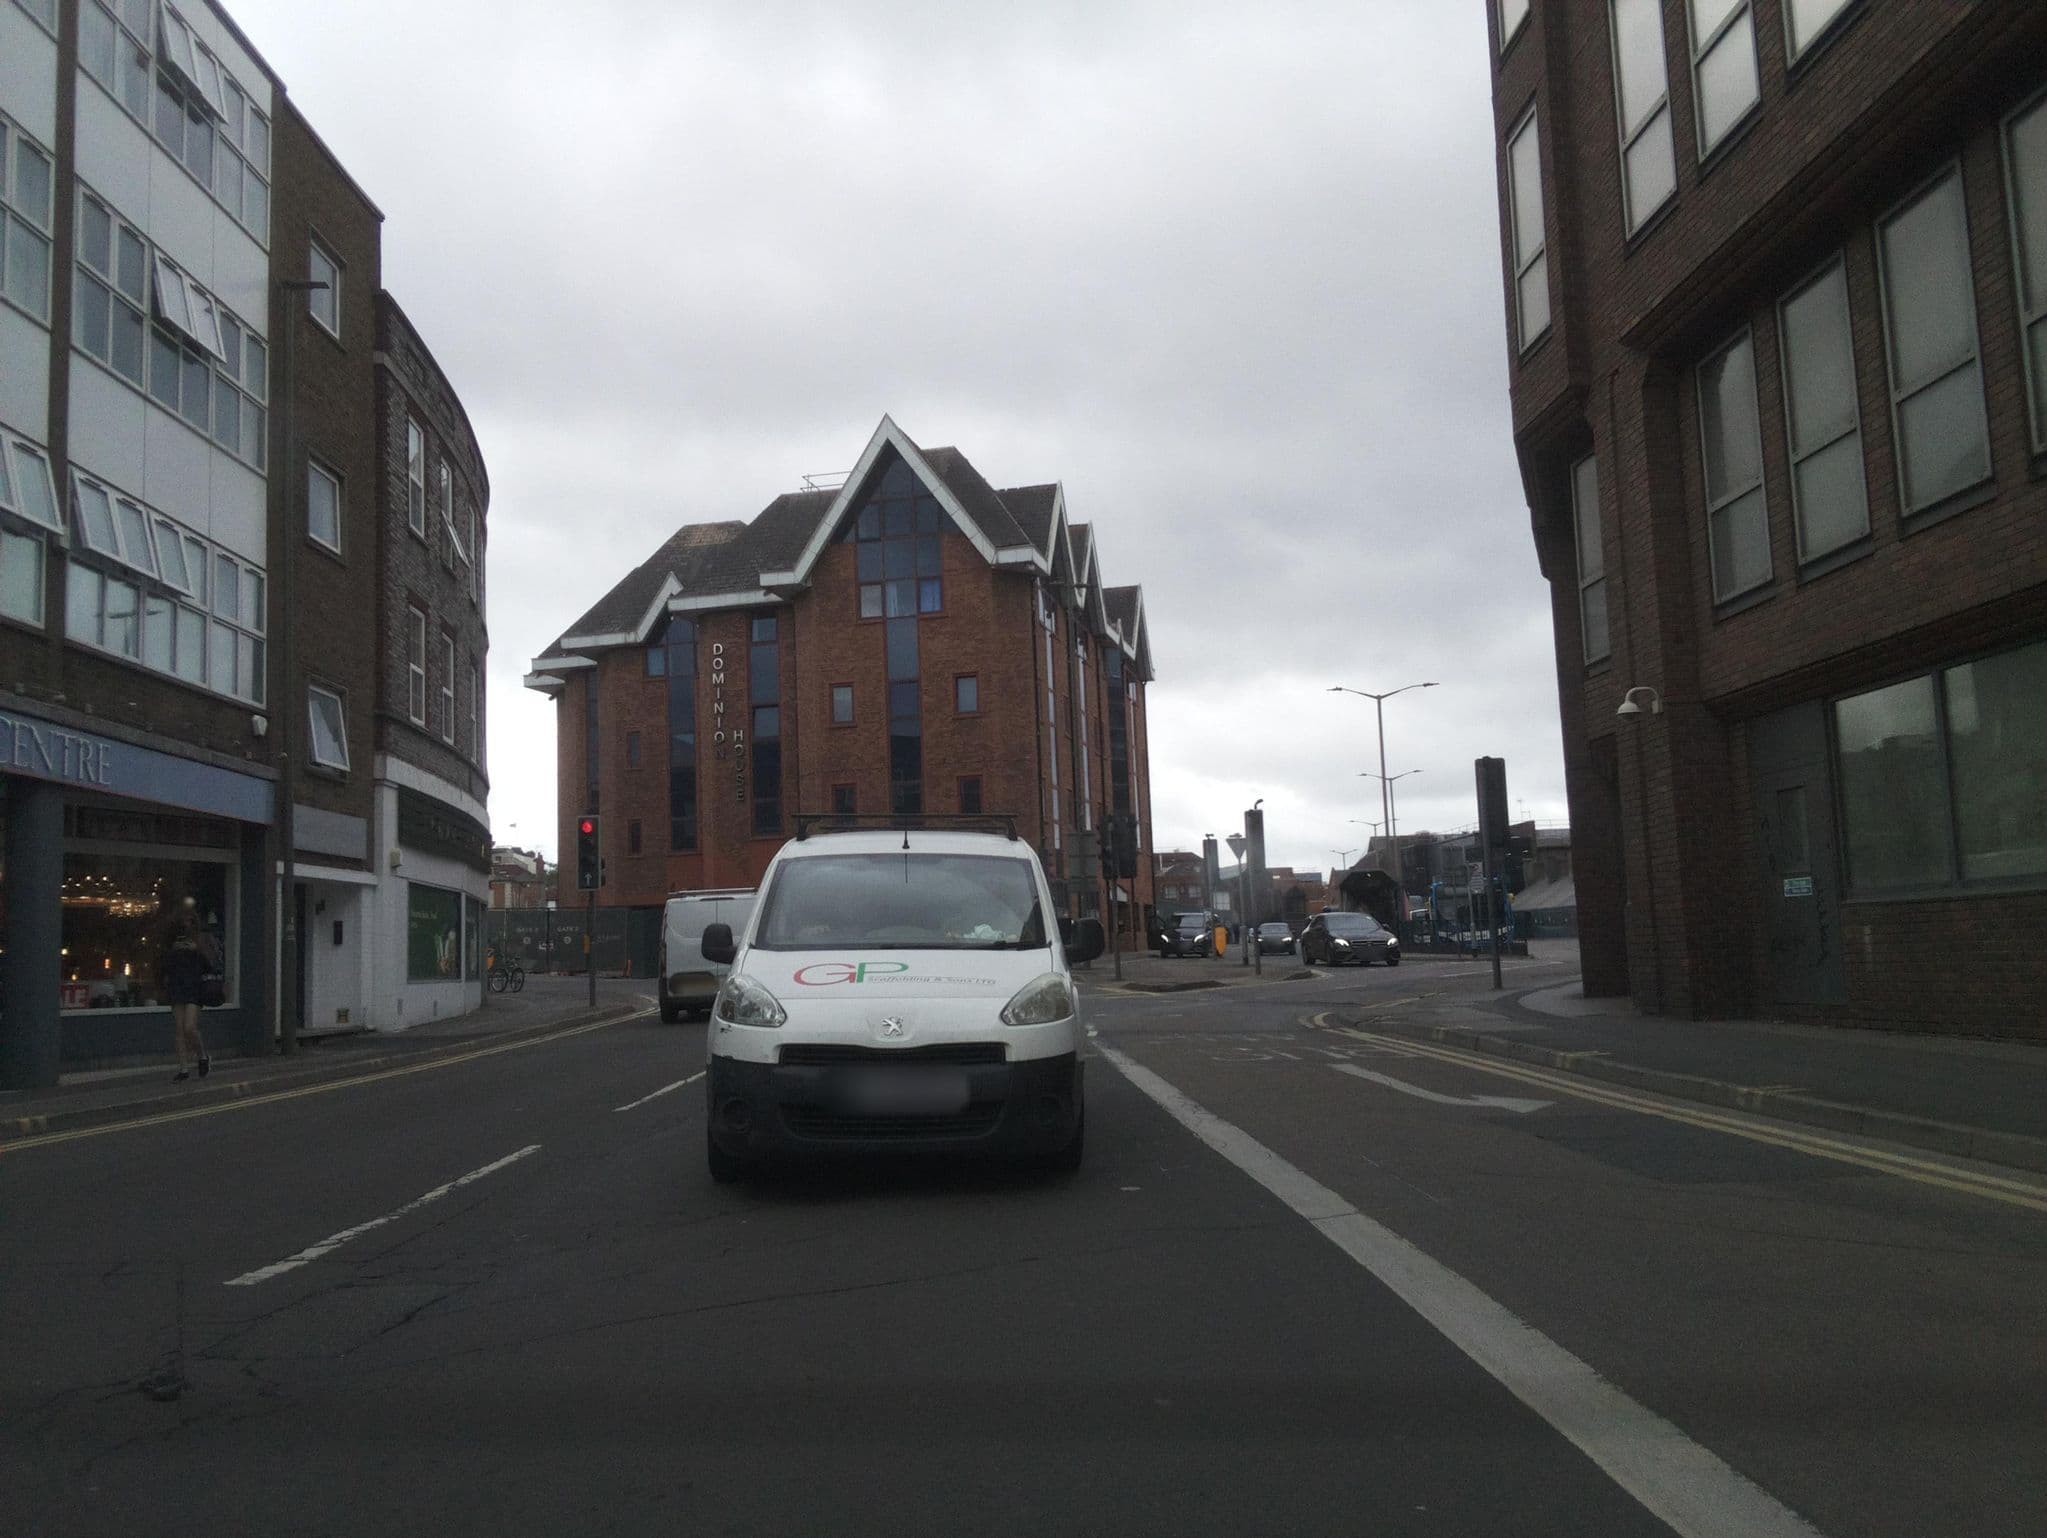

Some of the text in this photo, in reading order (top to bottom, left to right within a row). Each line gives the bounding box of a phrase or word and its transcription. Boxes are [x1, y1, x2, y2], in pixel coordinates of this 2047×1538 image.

[712, 642, 726, 761] DOMINION
[733, 730, 746, 802] HOUSE
[793, 962, 909, 986] GP
